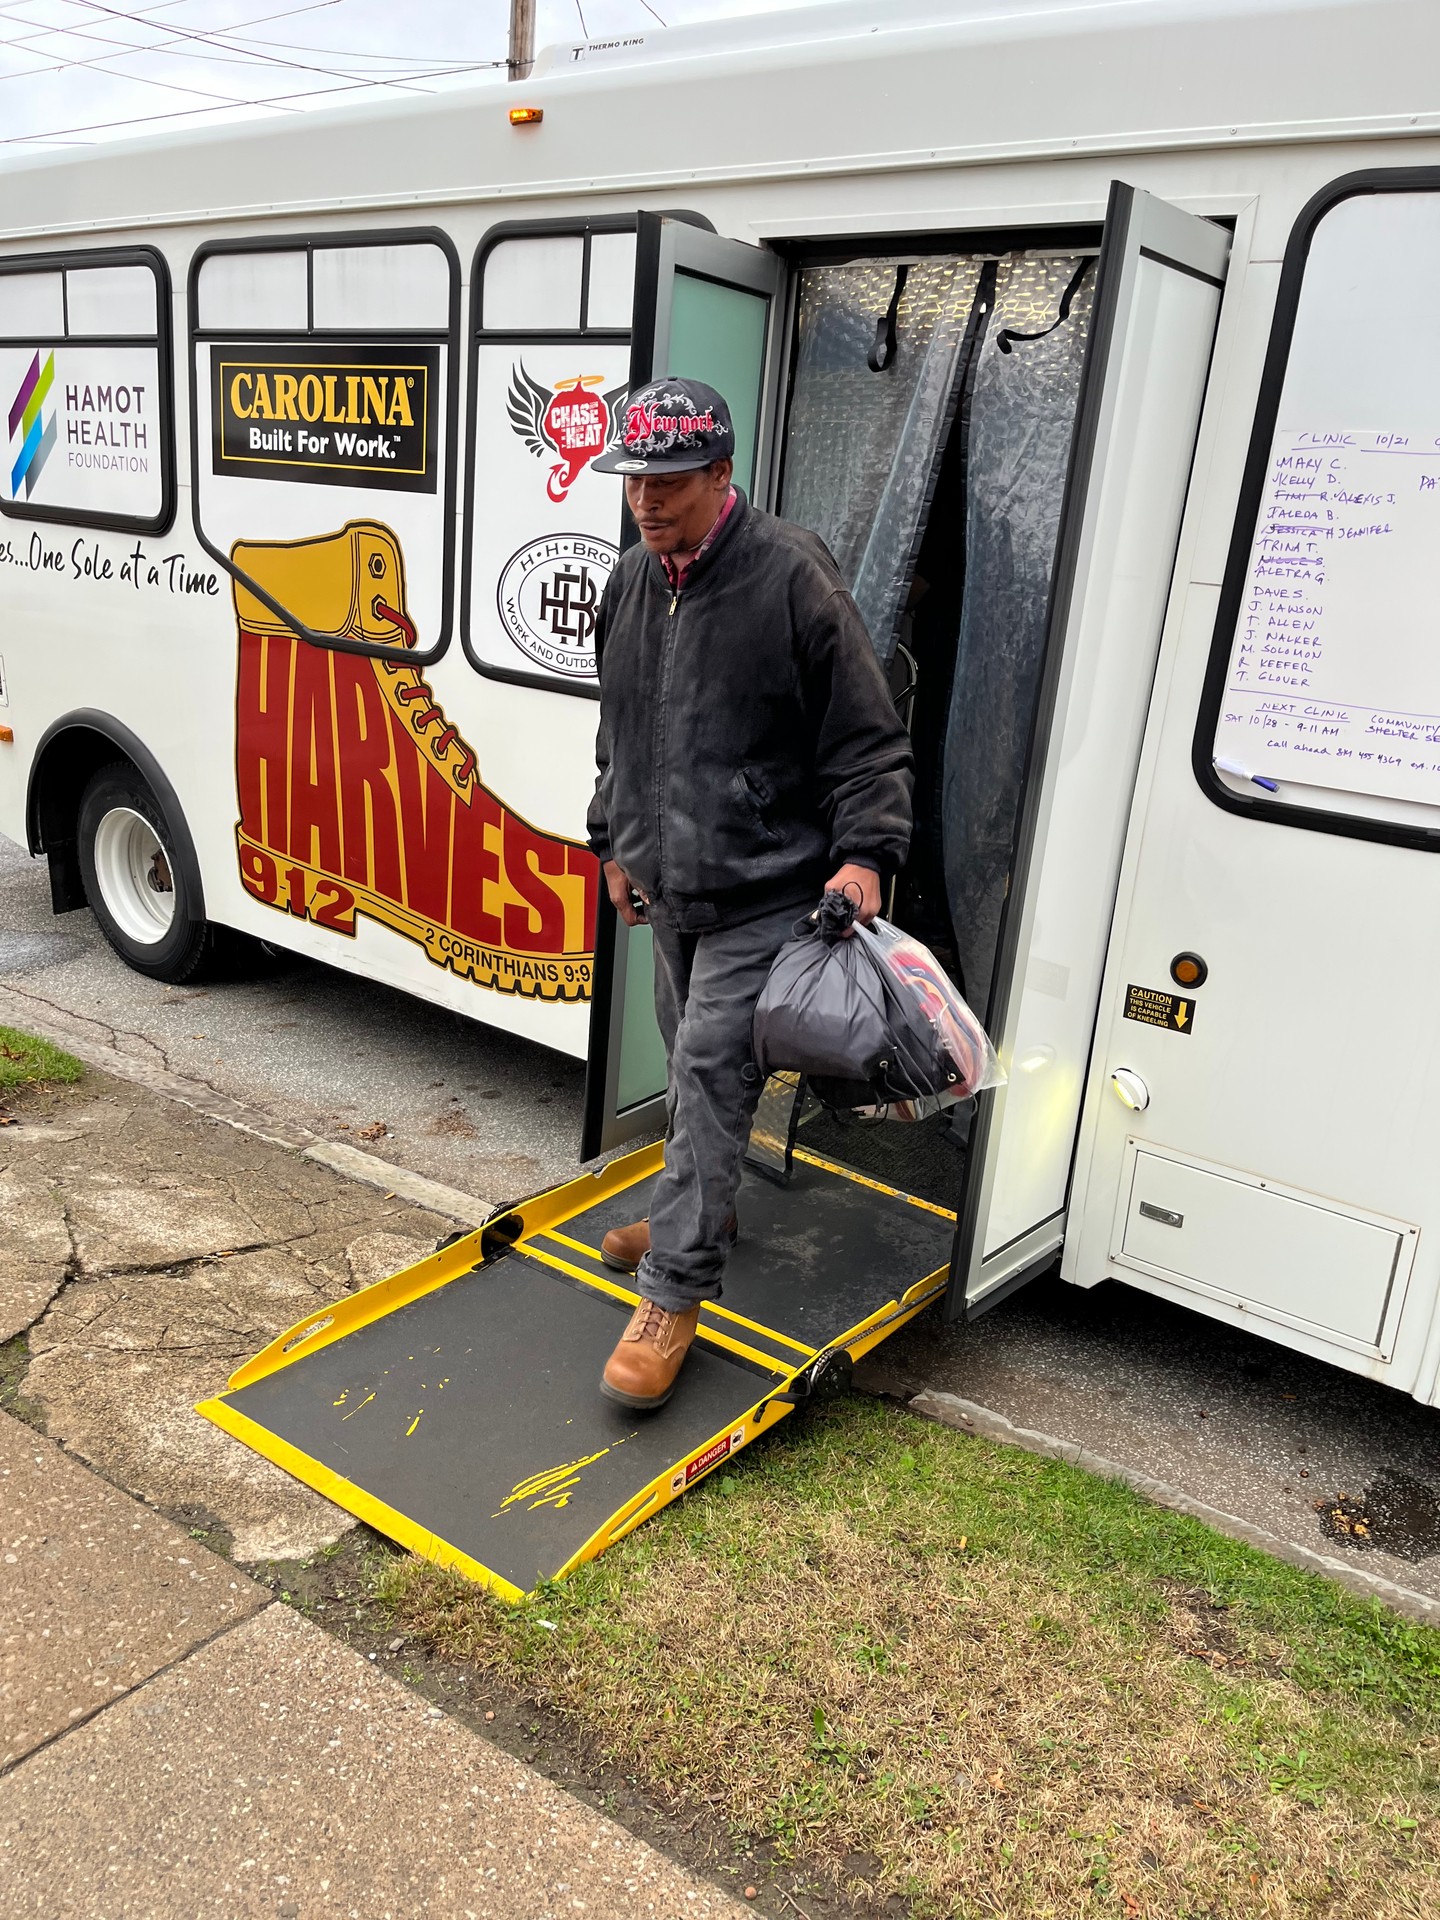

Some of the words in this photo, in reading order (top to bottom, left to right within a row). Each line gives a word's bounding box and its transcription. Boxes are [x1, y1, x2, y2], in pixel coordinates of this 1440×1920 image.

[589, 41, 620, 51] THERMO
[623, 38, 644, 47] KING
[66, 385, 145, 414] HAMOT
[551, 401, 599, 429] CHASE
[623, 402, 677, 447] New
[67, 420, 147, 449] HEALTH
[250, 428, 293, 452] Built
[297, 430, 330, 454] For
[566, 423, 602, 449] HEAT
[1299, 433, 1356, 445] CLINIC
[1376, 434, 1409, 448] 10/21
[68, 452, 148, 473] FOUNDATION
[1279, 457, 1323, 473] MARY
[1330, 459, 1347, 470] C.
[1279, 473, 1315, 489] KELLY
[1327, 474, 1341, 484] D.
[1327, 510, 1339, 520] B.
[1261, 539, 1300, 552] TRINA
[71, 538, 114, 579] Sole
[120, 541, 146, 589] at
[147, 566, 159, 586] a
[162, 554, 219, 595] Time
[1254, 586, 1289, 599] DAVE
[1269, 602, 1323, 615] LAWSON
[1268, 616, 1315, 630] ALLEN
[506, 597, 530, 643] WORK
[529, 641, 554, 660] AND
[556, 653, 598, 668] OUTDO
[1261, 644, 1322, 659] SOLOMON
[1260, 659, 1313, 673] KEEFER
[1258, 672, 1310, 687] GLOVER
[1262, 703, 1296, 712] NEXT
[1304, 706, 1349, 719] CLINIC
[1225, 714, 1243, 722] SAT
[1322, 726, 1339, 736] AM
[1294, 744, 1331, 756] ahead
[425, 928, 435, 945] 2
[439, 935, 558, 982] CORINTHIANS
[564, 964, 594, 982] 9:9
[1131, 988, 1172, 1004] CAUTION
[1130, 998, 1143, 1007] THIS
[1144, 1001, 1171, 1013] VEHICLE
[1138, 1007, 1167, 1019] CAPABLE
[1137, 1014, 1169, 1027] KNEELING
[698, 1441, 727, 1467] DANGER
